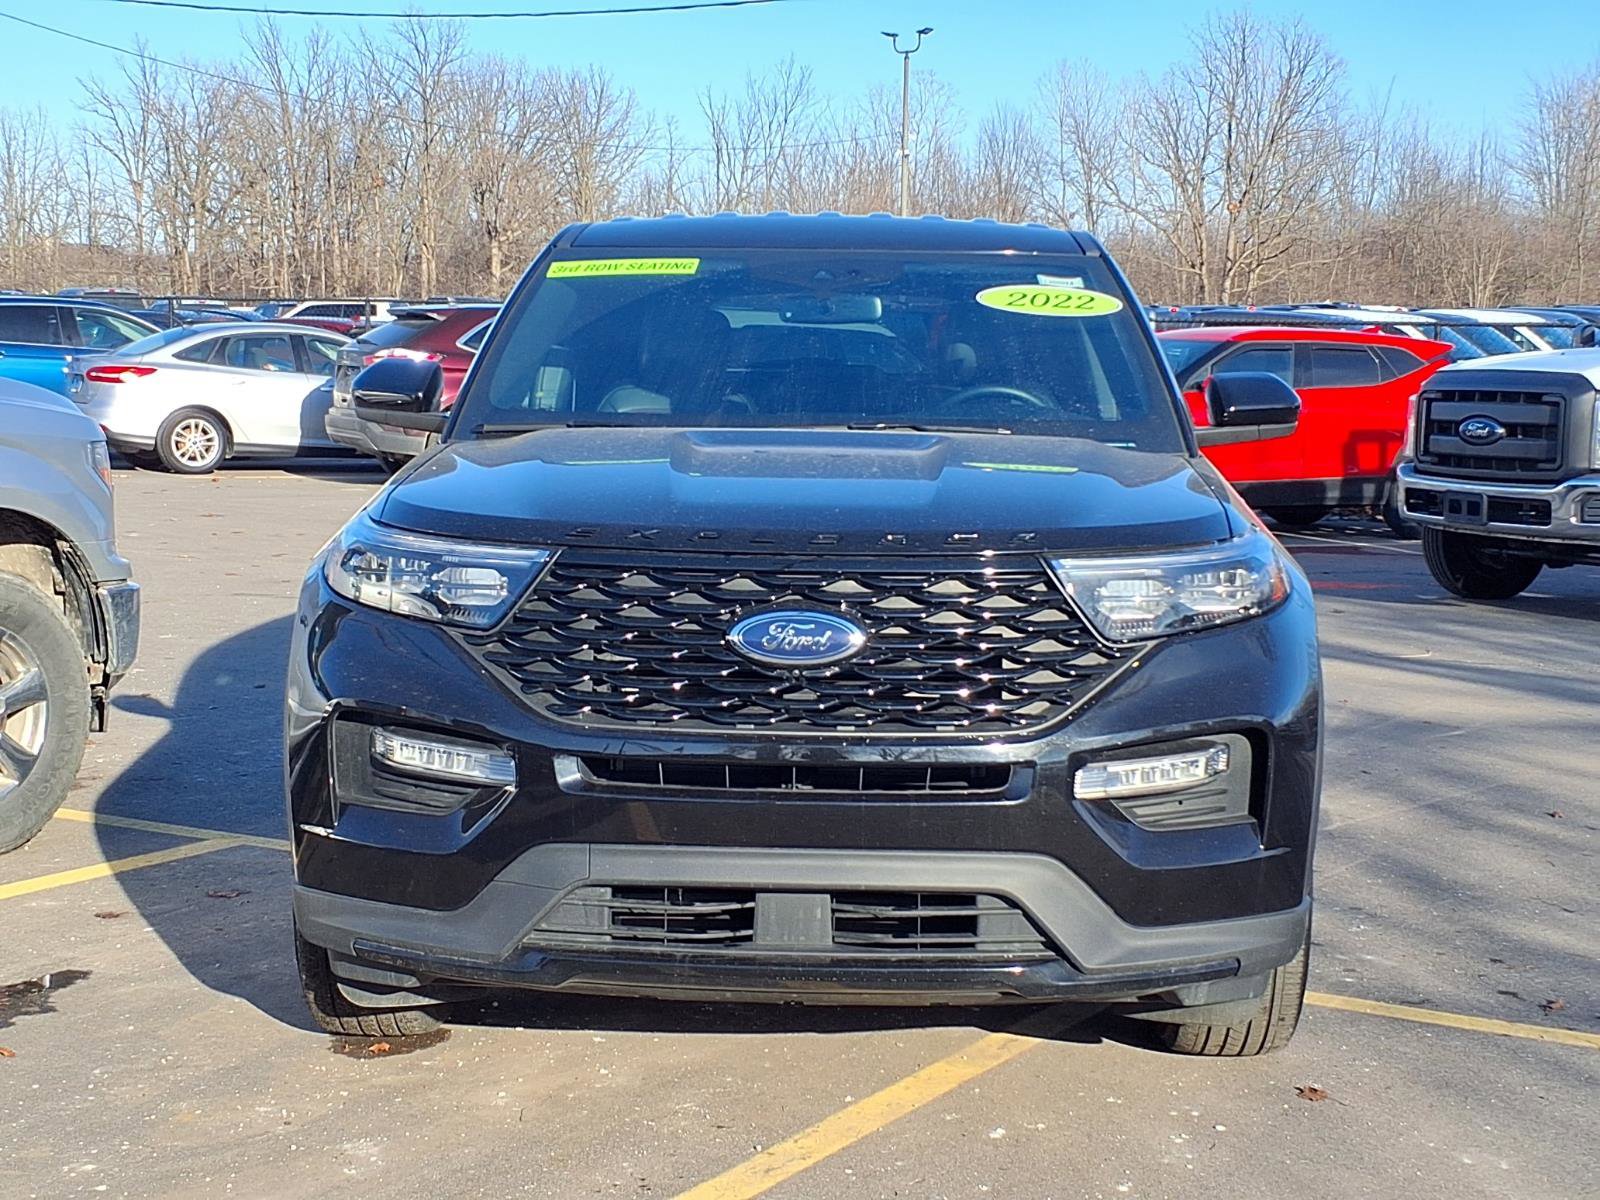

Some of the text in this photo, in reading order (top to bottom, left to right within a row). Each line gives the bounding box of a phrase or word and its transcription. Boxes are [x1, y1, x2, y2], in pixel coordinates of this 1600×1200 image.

[552, 261, 695, 273] 3rd ROW SEATING
[1006, 291, 1095, 310] 2022
[1466, 422, 1488, 437] Ford
[761, 621, 832, 651] Ford
